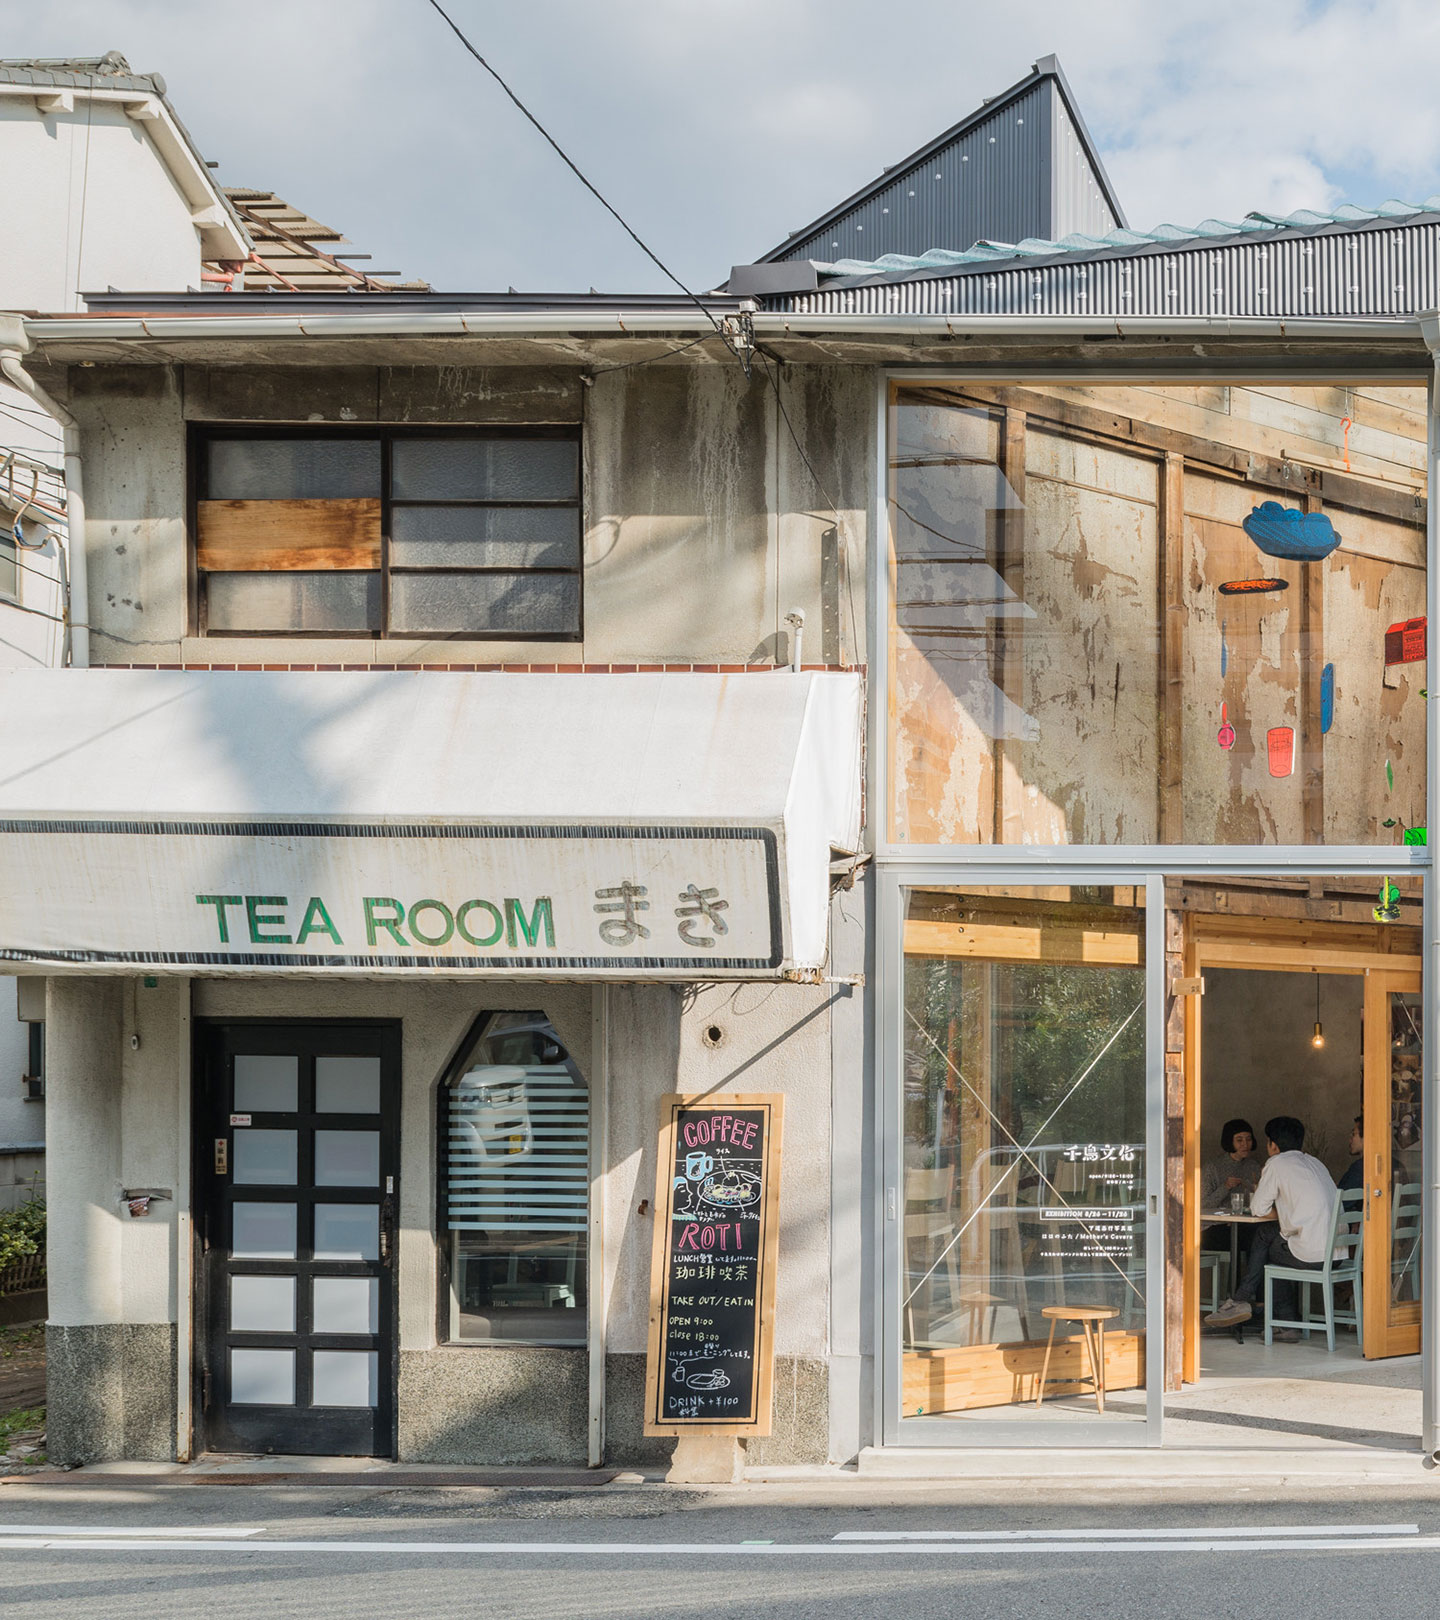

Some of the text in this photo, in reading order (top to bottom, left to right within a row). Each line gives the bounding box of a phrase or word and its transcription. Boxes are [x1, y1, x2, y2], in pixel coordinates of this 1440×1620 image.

[195, 881, 730, 949] TEA ROOM まき
[683, 1115, 759, 1149] COFFEE
[1063, 1144, 1135, 1161] 千鳥文化
[678, 1223, 742, 1250] ROTI
[675, 1264, 749, 1281] 珈琲喫茶
[671, 1295, 694, 1306] TAKE
[669, 1316, 714, 1326] OPEN 9:00
[669, 1329, 720, 1342] close 18:00
[669, 1395, 705, 1409] DRINK
